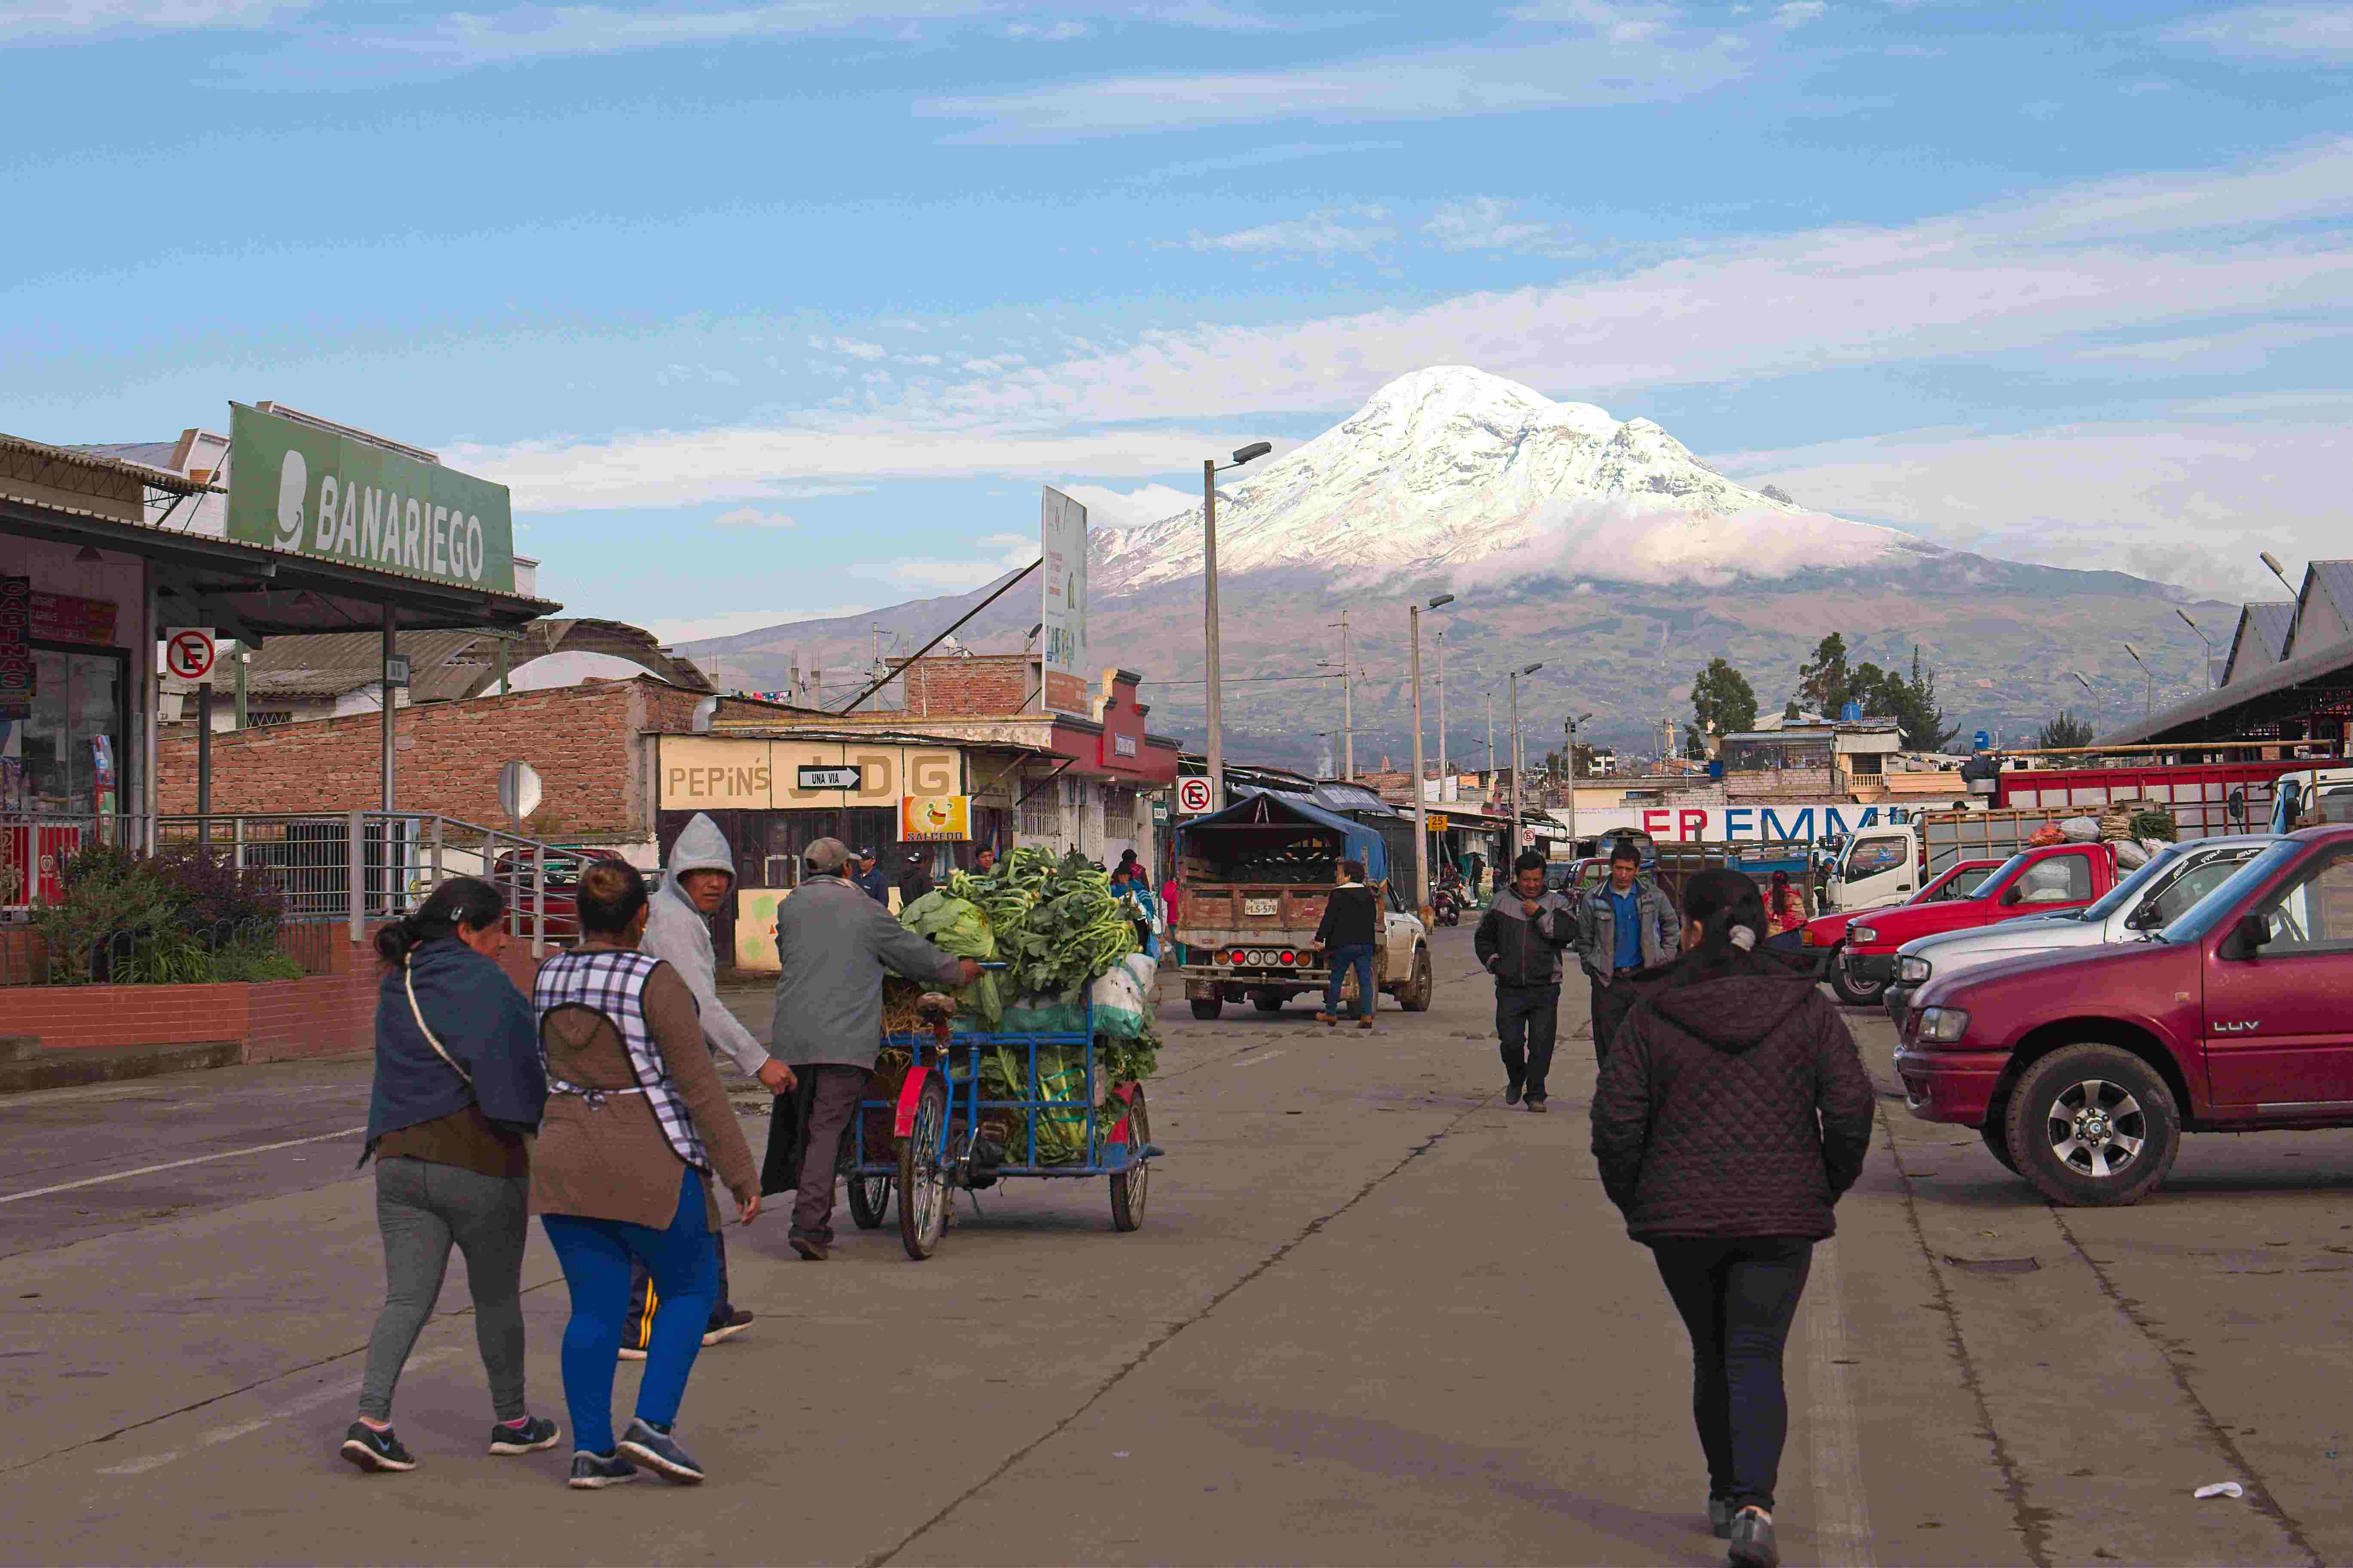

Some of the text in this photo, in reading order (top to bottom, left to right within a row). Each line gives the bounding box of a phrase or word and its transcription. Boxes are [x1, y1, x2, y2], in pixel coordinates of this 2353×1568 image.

[316, 475, 483, 581] BANARIEGO
[0, 581, 28, 689] CABINAS
[812, 773, 839, 784] UNA VIA
[1432, 817, 1443, 825] 25
[907, 832, 963, 841] SALCEDO
[2214, 1021, 2260, 1031] LUV
